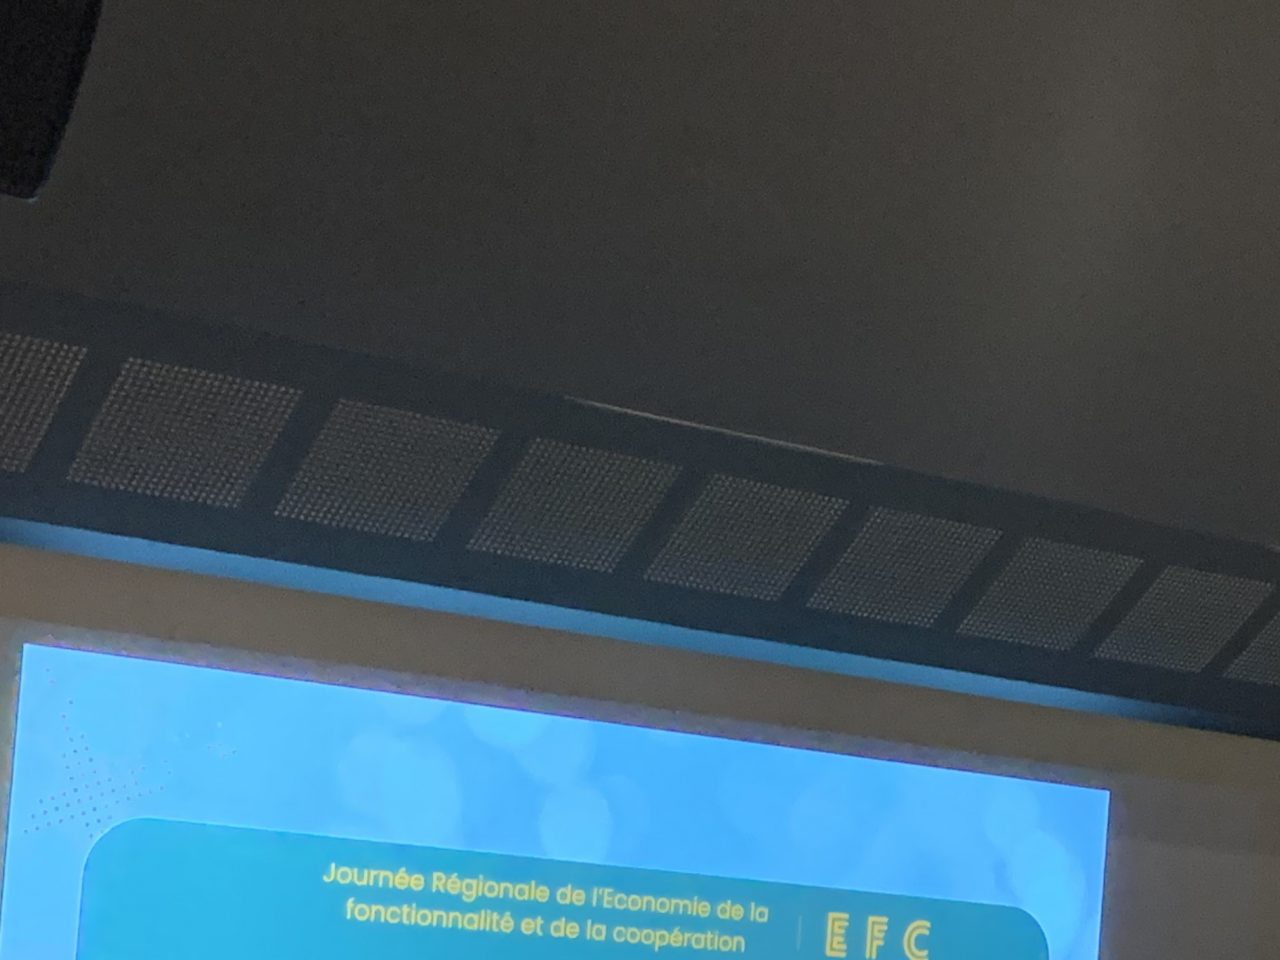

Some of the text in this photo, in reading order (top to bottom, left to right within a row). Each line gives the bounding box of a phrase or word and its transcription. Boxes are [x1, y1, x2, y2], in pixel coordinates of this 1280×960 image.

[322, 861, 425, 892] Journée
[431, 870, 550, 904] Régionale
[556, 880, 586, 905] de
[716, 896, 746, 920] de
[749, 899, 770, 923] la
[344, 896, 746, 954] fonctionnalité et de la coopération
